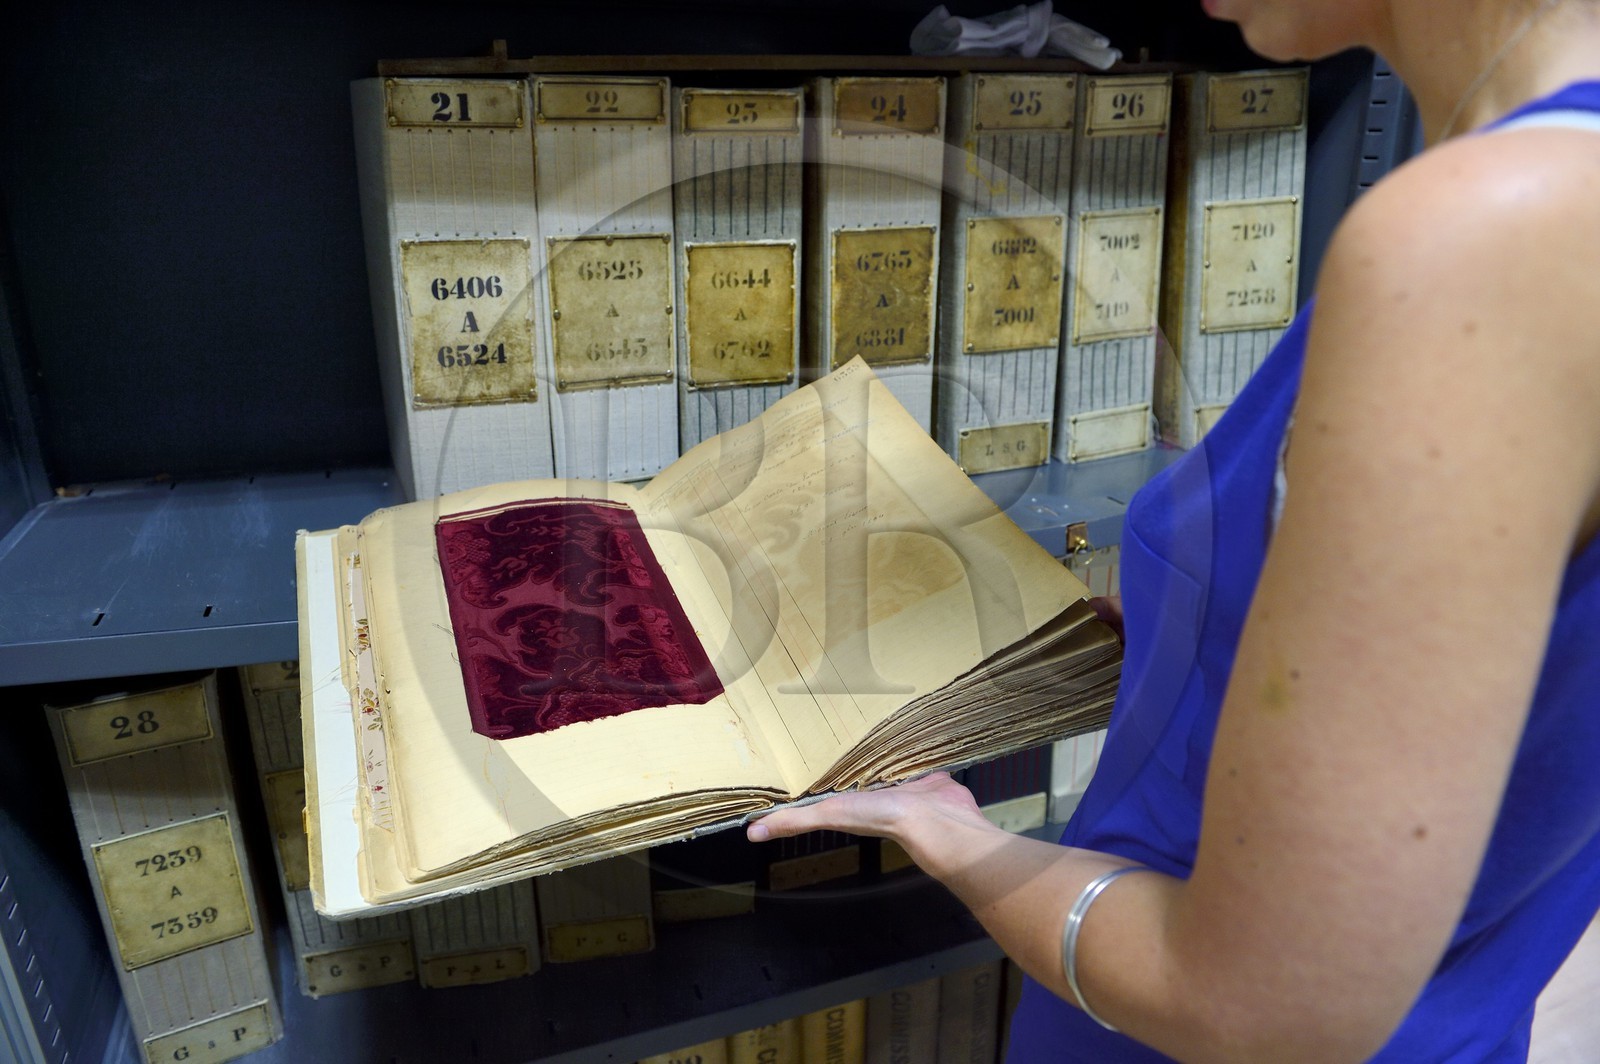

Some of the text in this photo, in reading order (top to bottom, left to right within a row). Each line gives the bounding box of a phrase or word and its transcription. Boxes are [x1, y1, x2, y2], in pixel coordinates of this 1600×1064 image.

[431, 92, 471, 122] 21
[586, 90, 618, 113] 22
[871, 95, 906, 122] 24
[1009, 90, 1042, 116] 25
[1112, 92, 1144, 120] 26
[1241, 88, 1274, 114] 27
[726, 102, 758, 124] 23
[1100, 233, 1140, 251] 7002
[1232, 223, 1275, 241] 7120
[992, 237, 1037, 255] 6882
[578, 260, 643, 281] 6525
[1246, 258, 1257, 273] A
[431, 276, 503, 300] 6406
[711, 268, 771, 289] 6644
[1006, 273, 1020, 290] A
[605, 303, 620, 318] A
[876, 293, 889, 307] A
[460, 311, 480, 333] A
[733, 307, 748, 321] A
[993, 306, 1035, 327] 7001
[856, 327, 905, 347] 6881
[437, 343, 508, 368] 6524
[713, 339, 771, 360] 6762
[1016, 439, 1026, 452] G
[110, 710, 160, 740] 28
[135, 845, 203, 878] 7239
[170, 885, 182, 899] A
[151, 906, 219, 940] 7359
[330, 964, 343, 978] G
[380, 956, 391, 968] P
[173, 1046, 189, 1061] G
[232, 1026, 247, 1042] P
